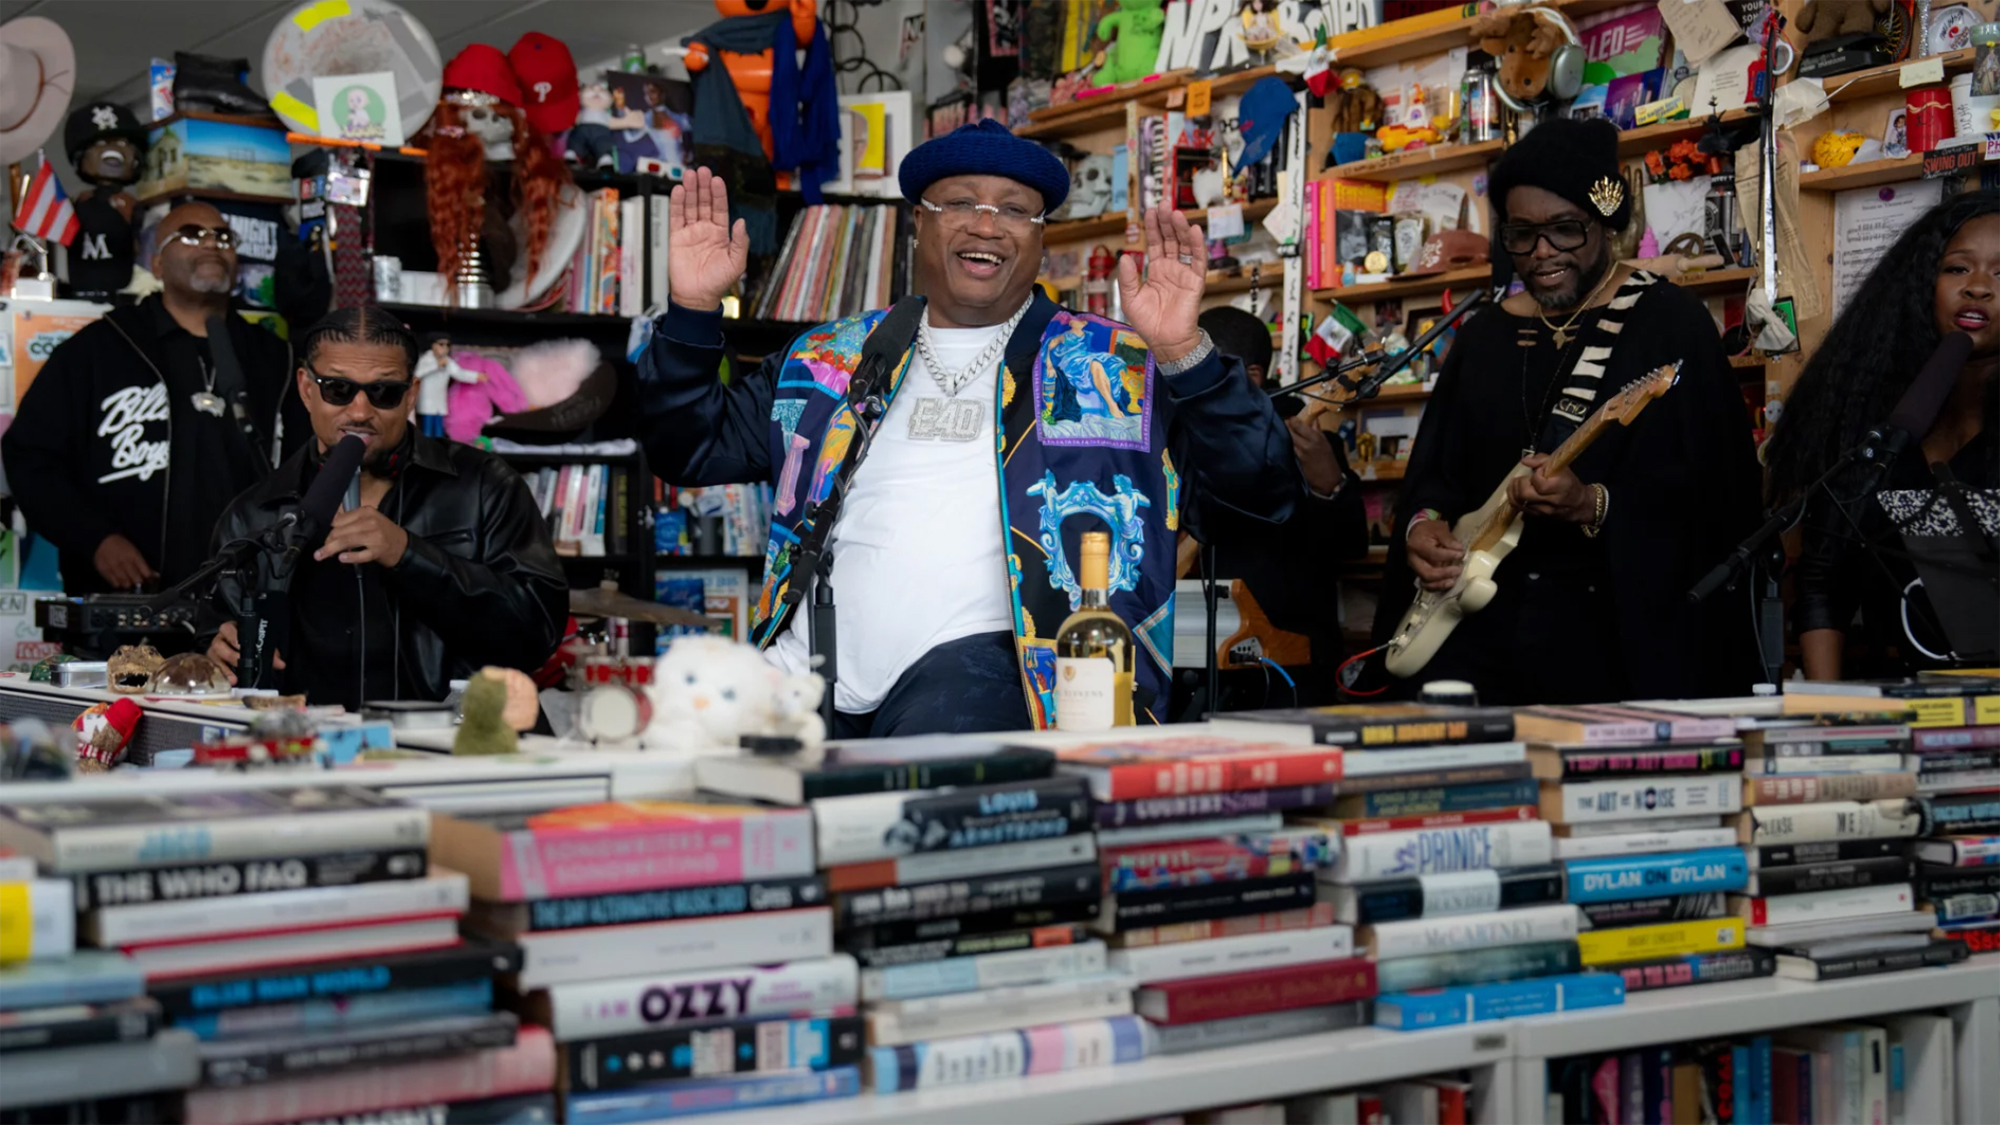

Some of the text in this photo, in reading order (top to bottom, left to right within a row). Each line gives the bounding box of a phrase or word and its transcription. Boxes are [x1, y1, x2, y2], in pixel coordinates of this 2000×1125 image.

[1742, 2, 1765, 13] YOUR
[1742, 14, 1759, 24] SON
[1153, 0, 1252, 73] NPR
[534, 81, 552, 103] P
[1177, 128, 1215, 149] ASK
[1923, 154, 1956, 174] SWING
[1957, 151, 1978, 168] OUT
[111, 424, 170, 481] Boys
[979, 789, 1038, 814] LOUIS
[1597, 791, 1617, 812] ART
[1634, 786, 1676, 811] NOISE
[950, 817, 1068, 847] ARMSTRONG
[1417, 827, 1492, 873] PRINCE
[94, 860, 307, 903] THE WHO FAQ
[1583, 863, 1726, 892] DYLAN ON DYLAN
[312, 965, 392, 993] WORLD
[637, 977, 754, 1024] OZZY
